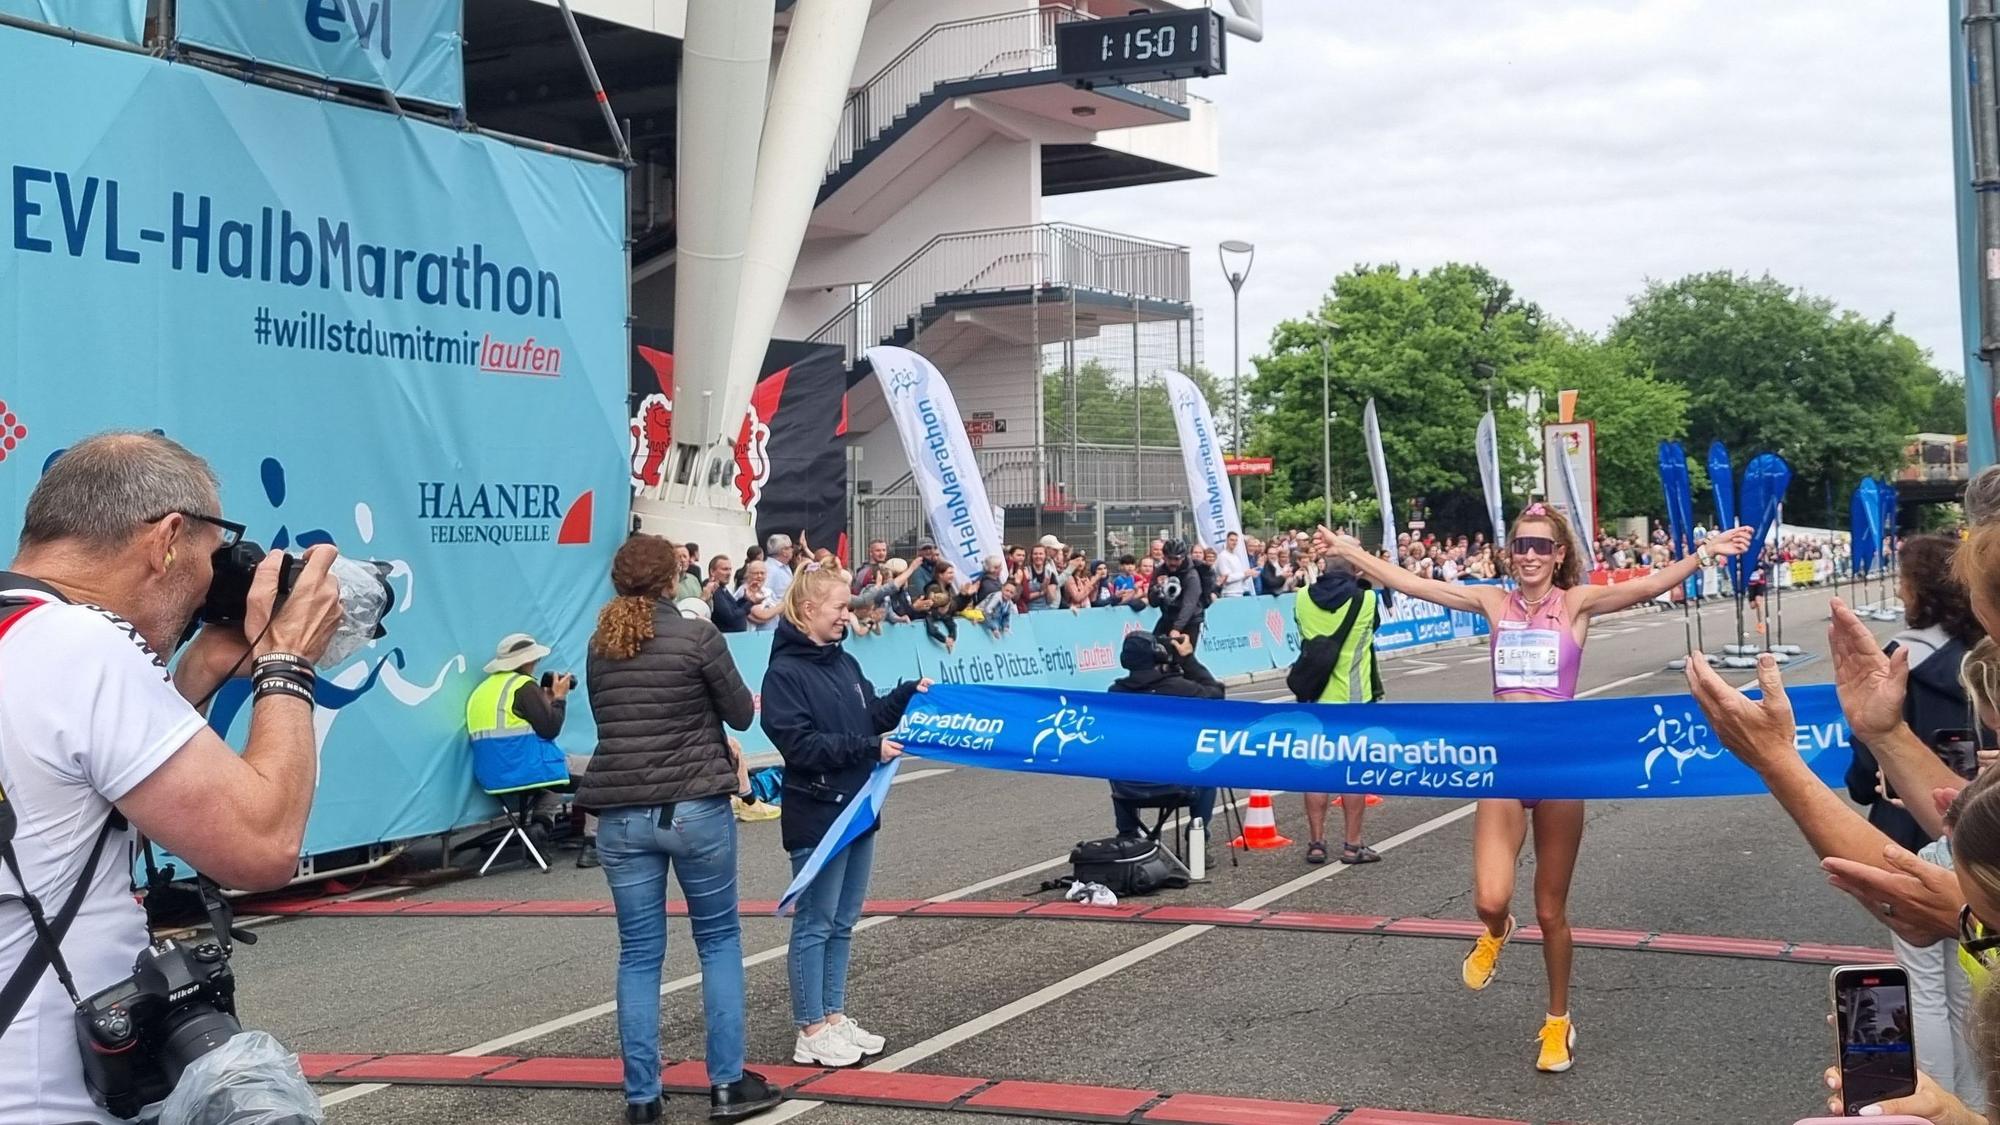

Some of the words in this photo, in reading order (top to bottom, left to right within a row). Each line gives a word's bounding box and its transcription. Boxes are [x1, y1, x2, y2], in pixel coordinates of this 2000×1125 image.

[304, 0, 392, 59] evl
[12, 165, 562, 319] EVL-HalbMarathon
[418, 482, 562, 519] HAANER
[430, 523, 551, 546] FELSENQUELLE
[262, 681, 284, 689] GYM
[939, 660, 966, 685] Auf
[969, 658, 994, 683] die
[1196, 728, 1498, 765] EVL-HalbMarathon
[1345, 766, 1494, 788] Leverkusen
[169, 984, 200, 1002] Nikon
